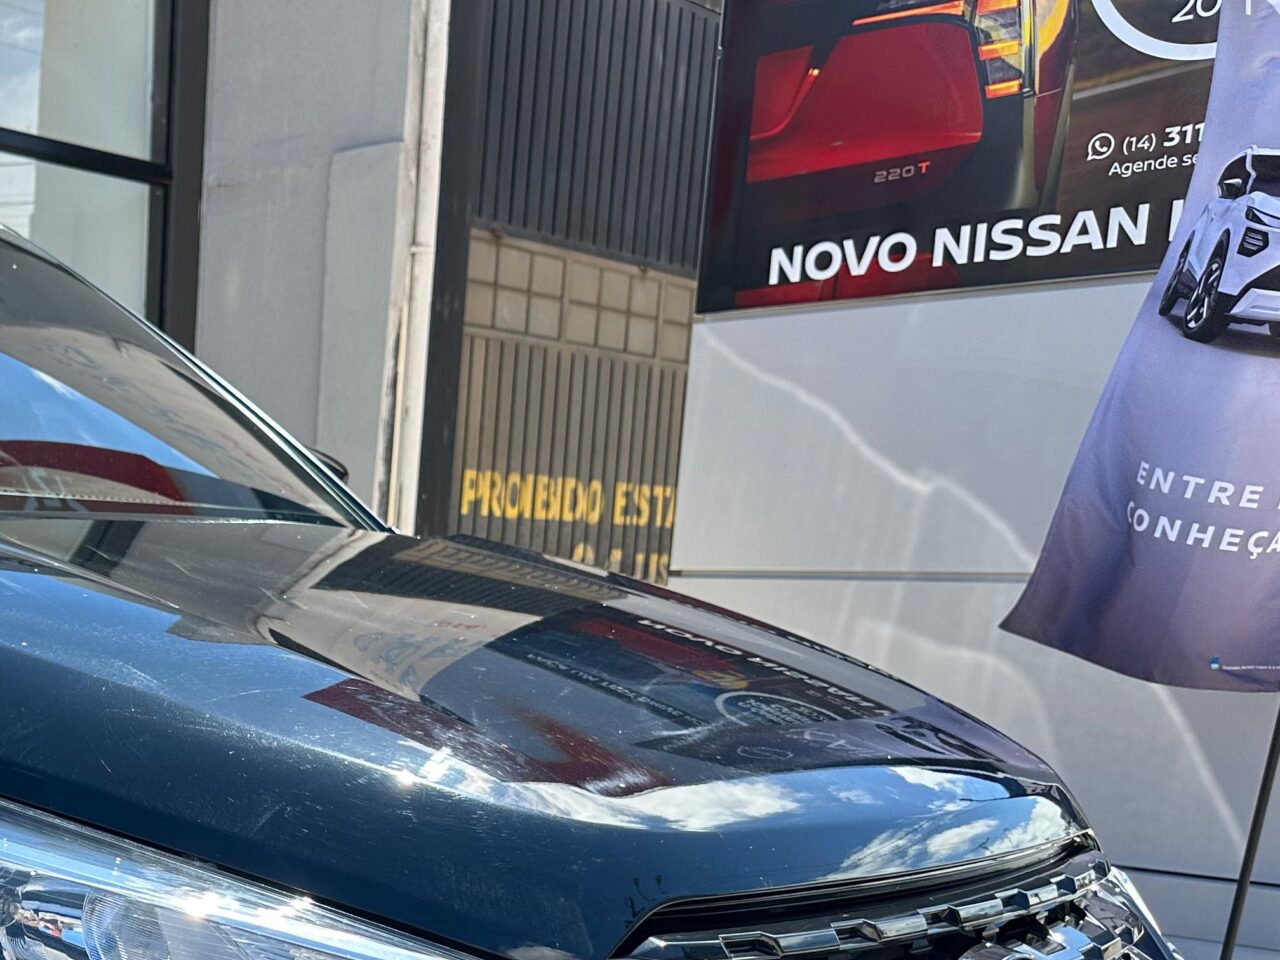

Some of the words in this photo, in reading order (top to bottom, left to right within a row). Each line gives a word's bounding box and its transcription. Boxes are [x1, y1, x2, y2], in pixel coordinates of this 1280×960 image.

[1108, 153, 1177, 178] Agende
[1122, 133, 1156, 156] (14)
[768, 231, 918, 286] NOVO
[932, 203, 1150, 268] NISSAN
[460, 468, 605, 526] PROIBIDO
[1136, 460, 1264, 509] ENTRE
